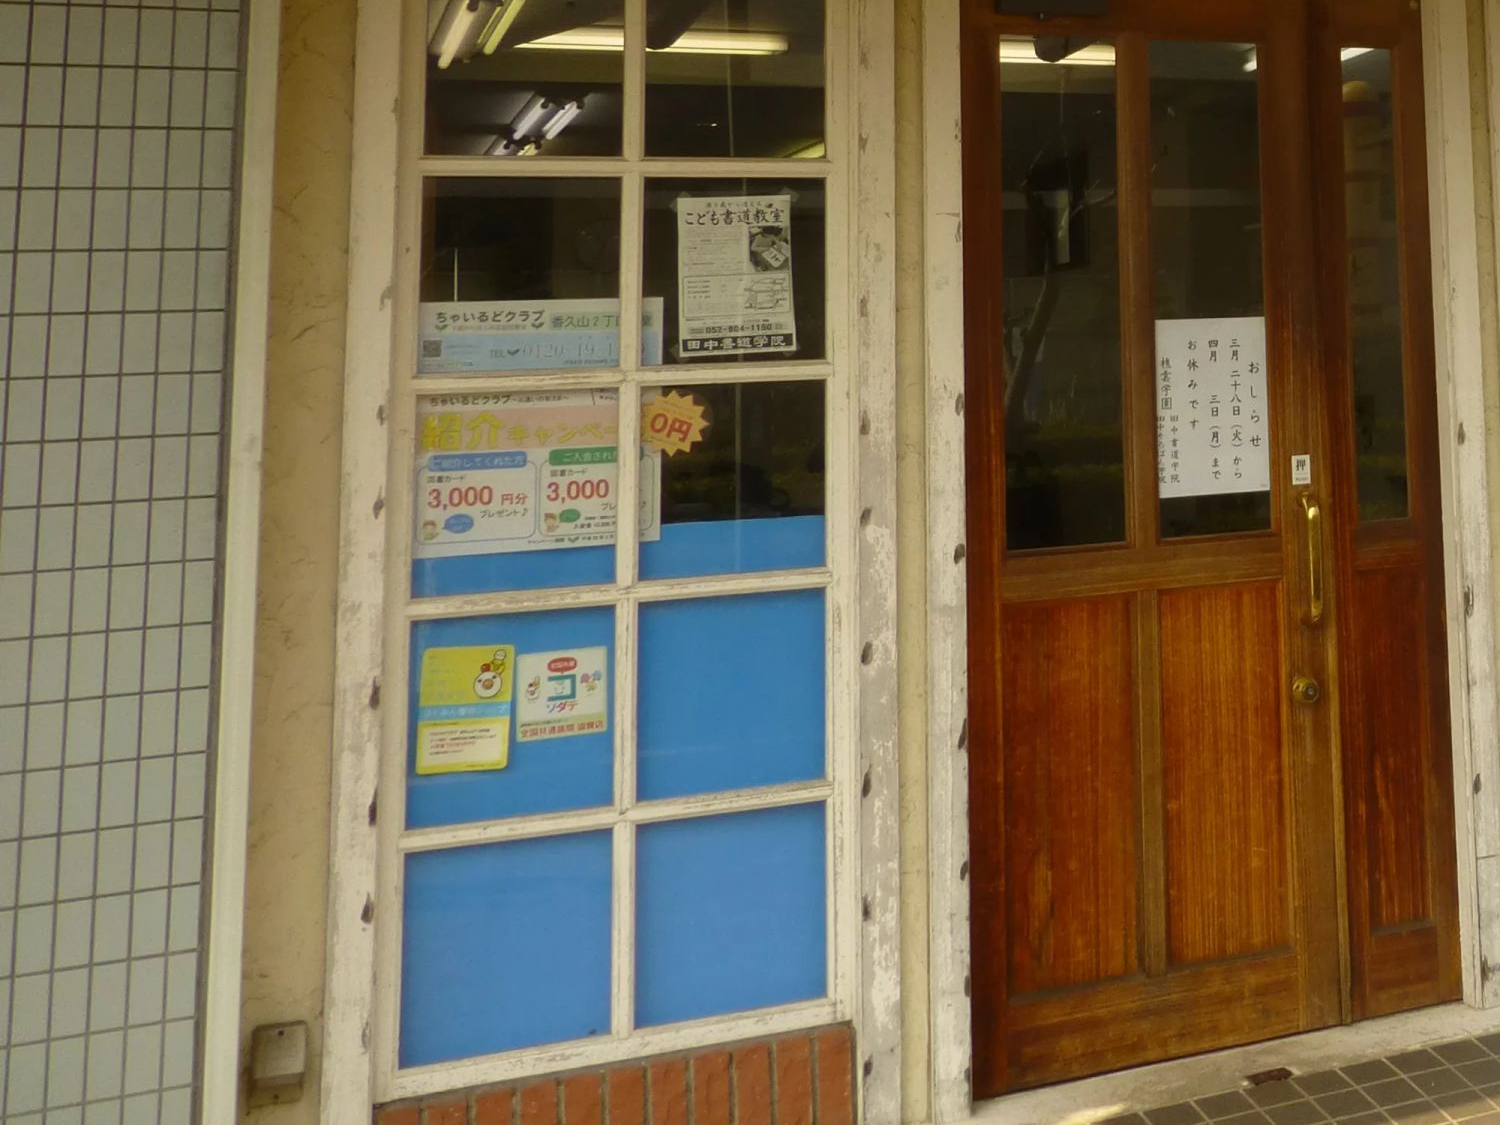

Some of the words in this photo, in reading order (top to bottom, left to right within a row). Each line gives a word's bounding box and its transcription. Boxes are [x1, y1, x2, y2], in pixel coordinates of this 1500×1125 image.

[685, 208, 785, 225] こども書道教室
[435, 309, 546, 324] ちゃいるどクラブ
[687, 336, 786, 350] 田中書道学院
[1187, 339, 1199, 430] お休みです
[1247, 360, 1262, 448] おしらせ
[420, 412, 619, 451] 紹介キャンペー
[648, 412, 693, 443] 0円
[1296, 459, 1306, 471] 押
[427, 485, 493, 511] 3,000
[500, 492, 529, 507] 円分
[546, 478, 609, 503] 3,000
